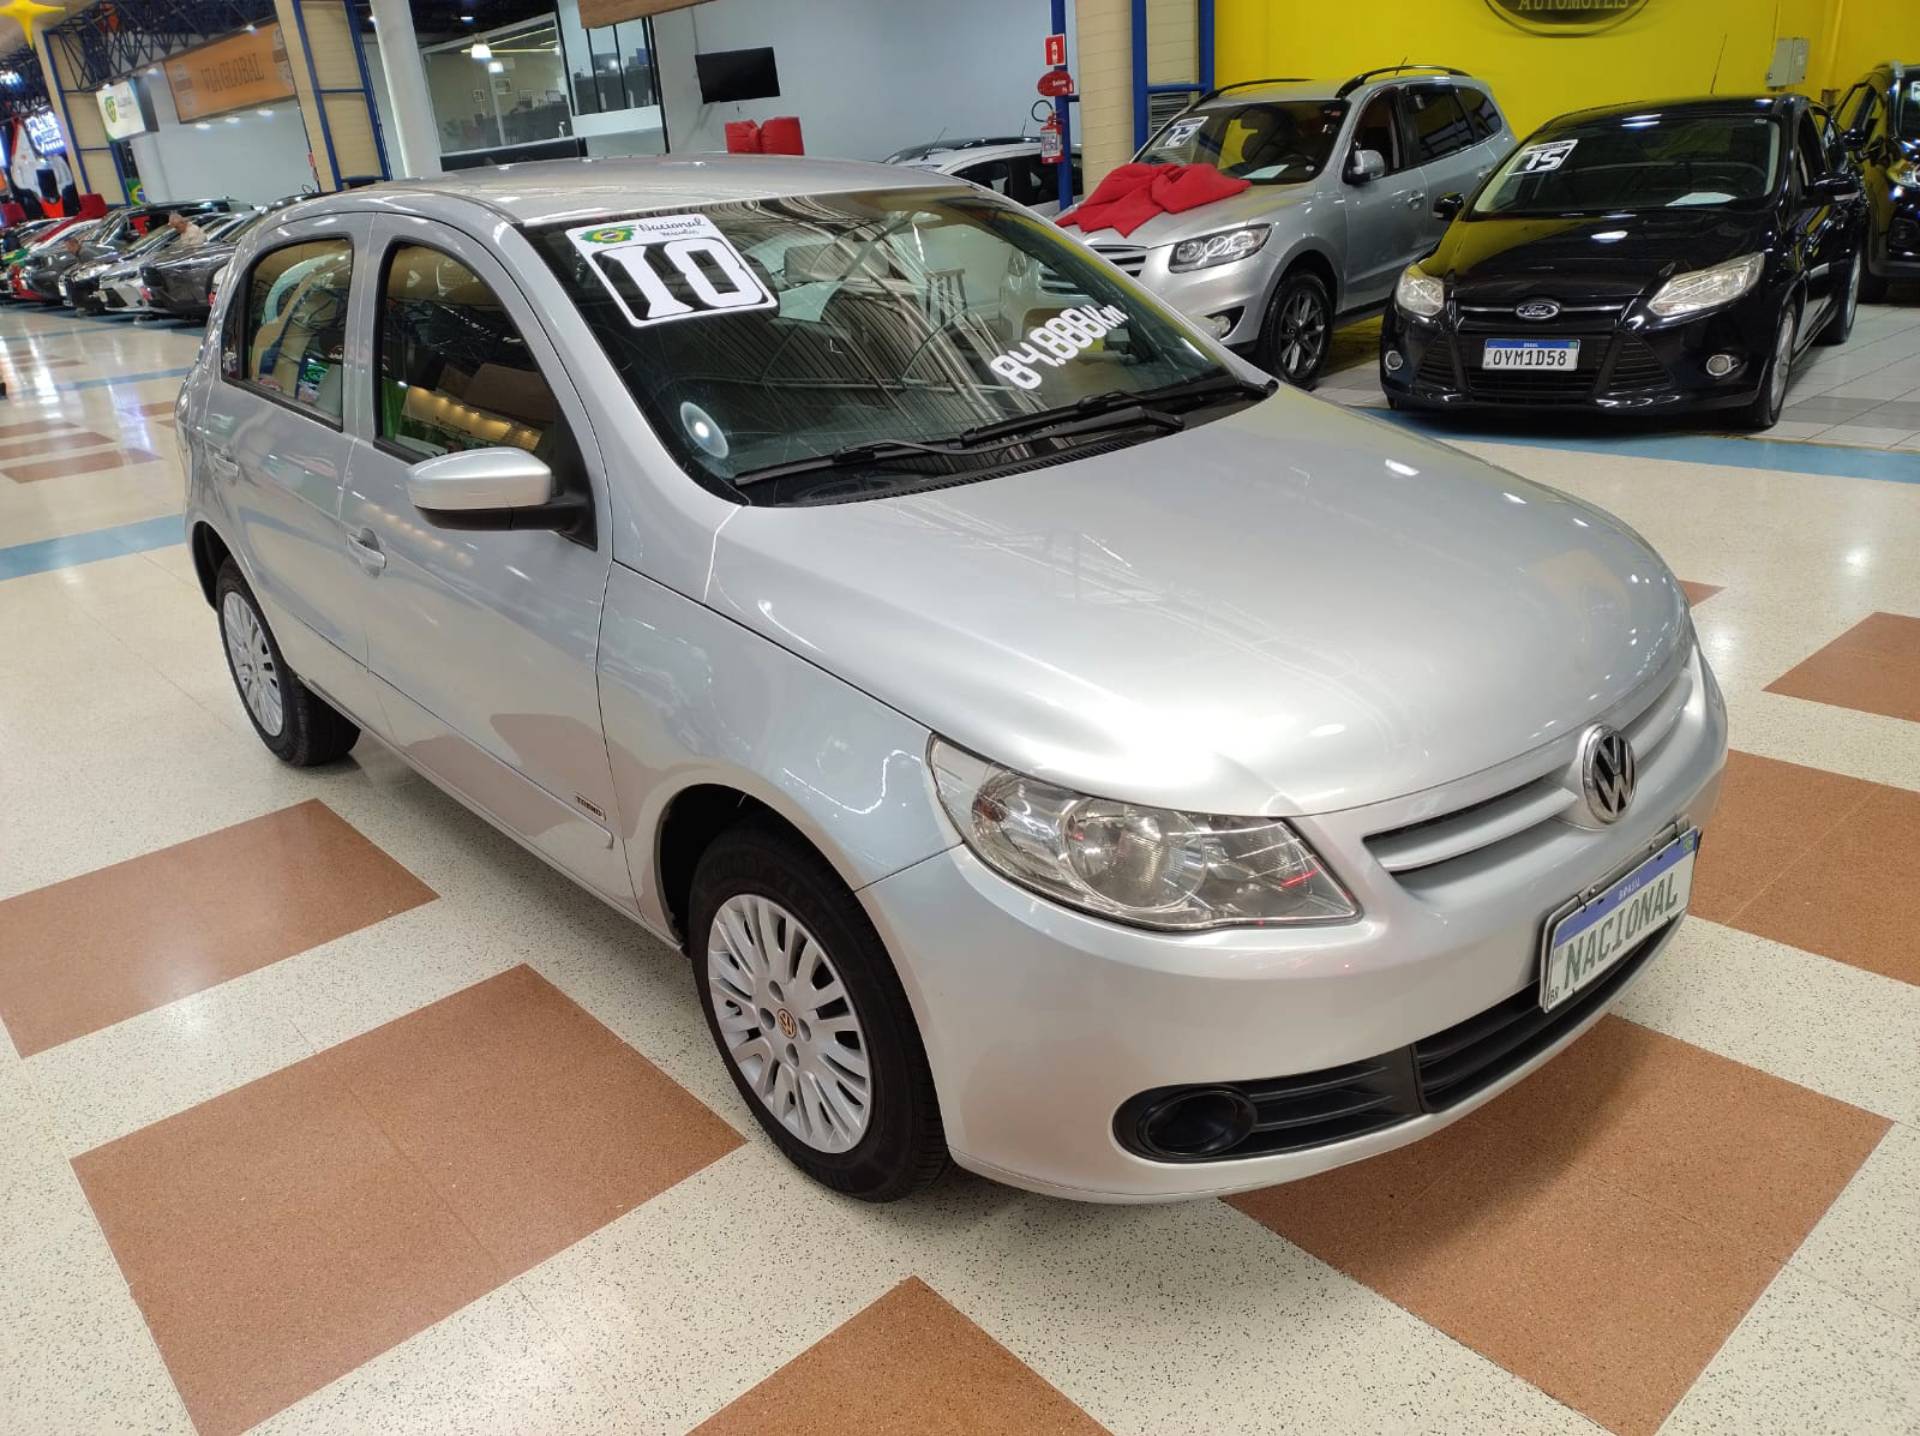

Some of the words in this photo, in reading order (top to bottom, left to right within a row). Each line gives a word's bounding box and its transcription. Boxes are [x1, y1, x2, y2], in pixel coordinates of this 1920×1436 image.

[1525, 149, 1564, 171] 15
[638, 216, 705, 232] Nacional
[601, 238, 763, 319] 10
[1493, 349, 1567, 367] OYM1D58
[1563, 872, 1679, 990] NACIONAL
